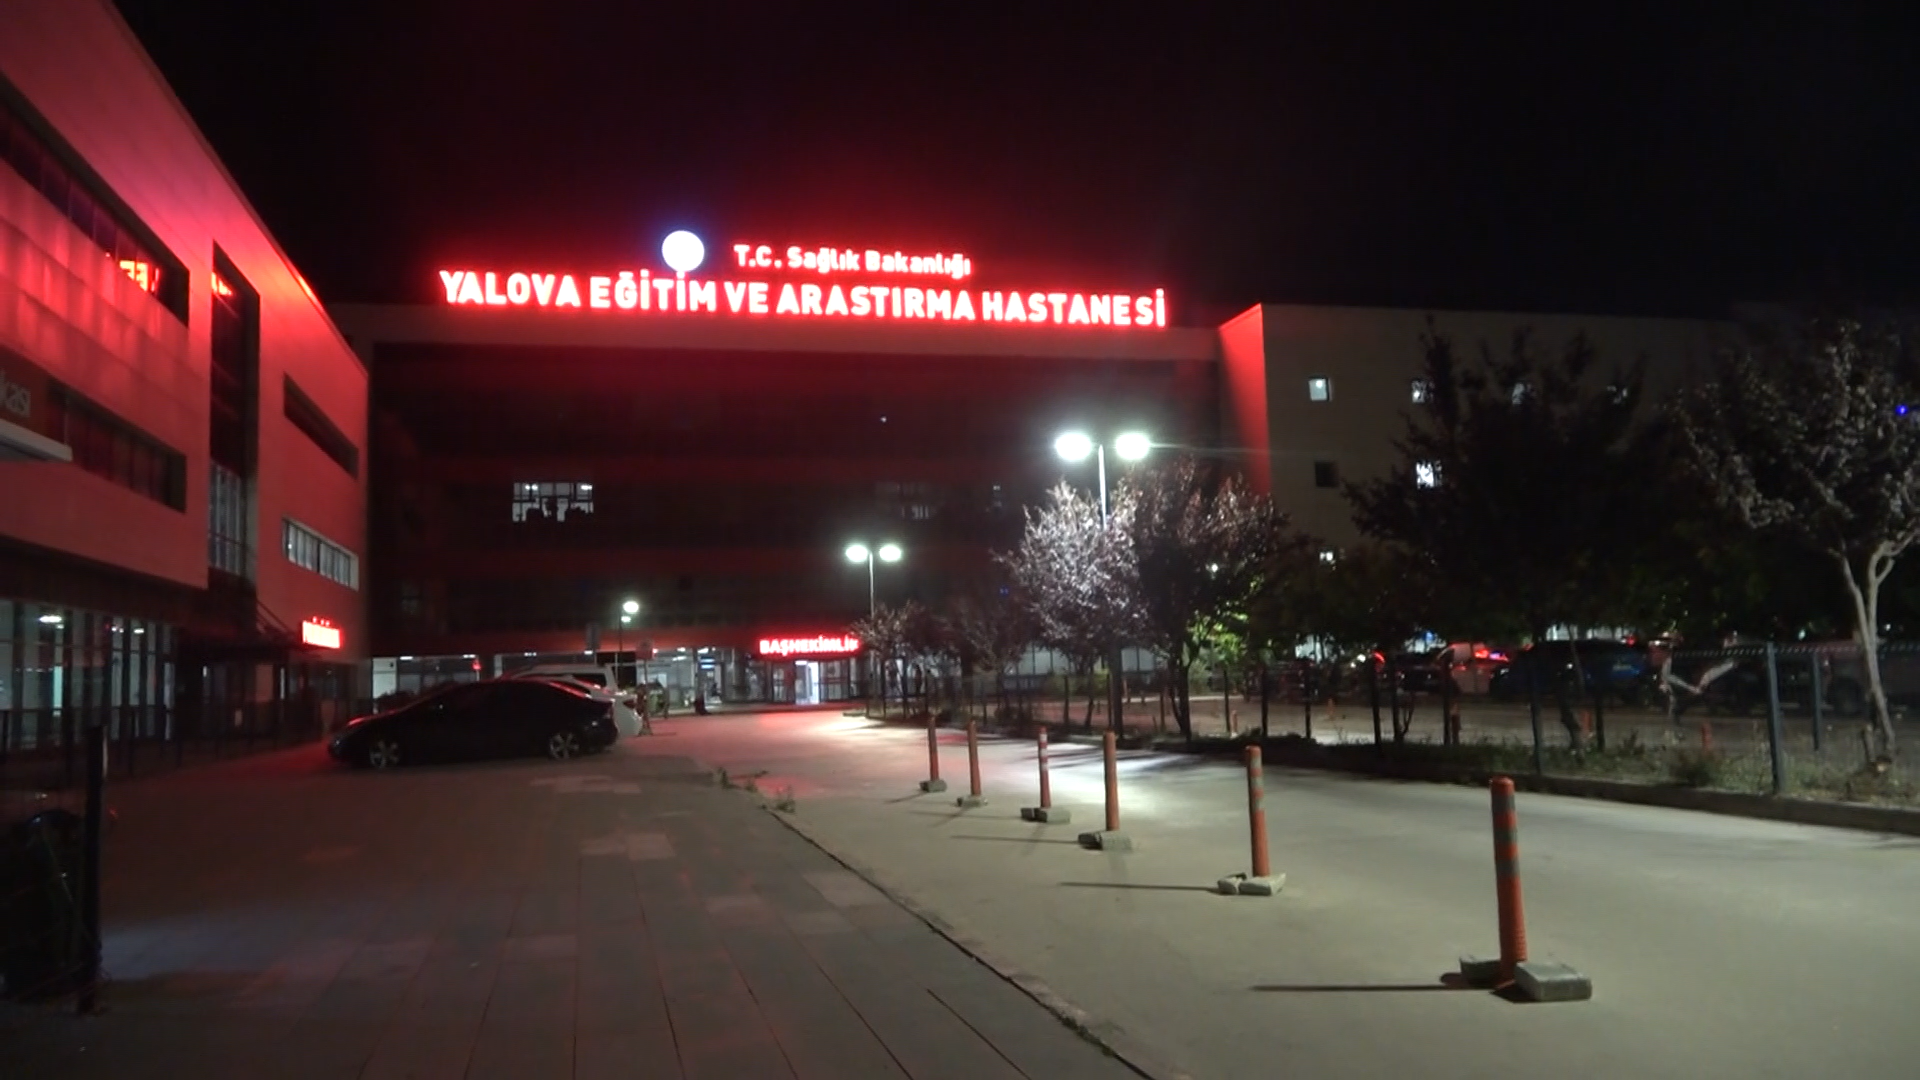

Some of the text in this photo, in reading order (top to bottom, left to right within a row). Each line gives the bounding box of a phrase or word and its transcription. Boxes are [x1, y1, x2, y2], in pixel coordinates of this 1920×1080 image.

[733, 244, 971, 280] T.C. Sağlık Bakanlığı
[439, 270, 582, 308] YALOVA
[590, 268, 717, 312] EĞİTİM
[723, 281, 769, 314] VE
[982, 288, 1166, 328] HASTANESİ
